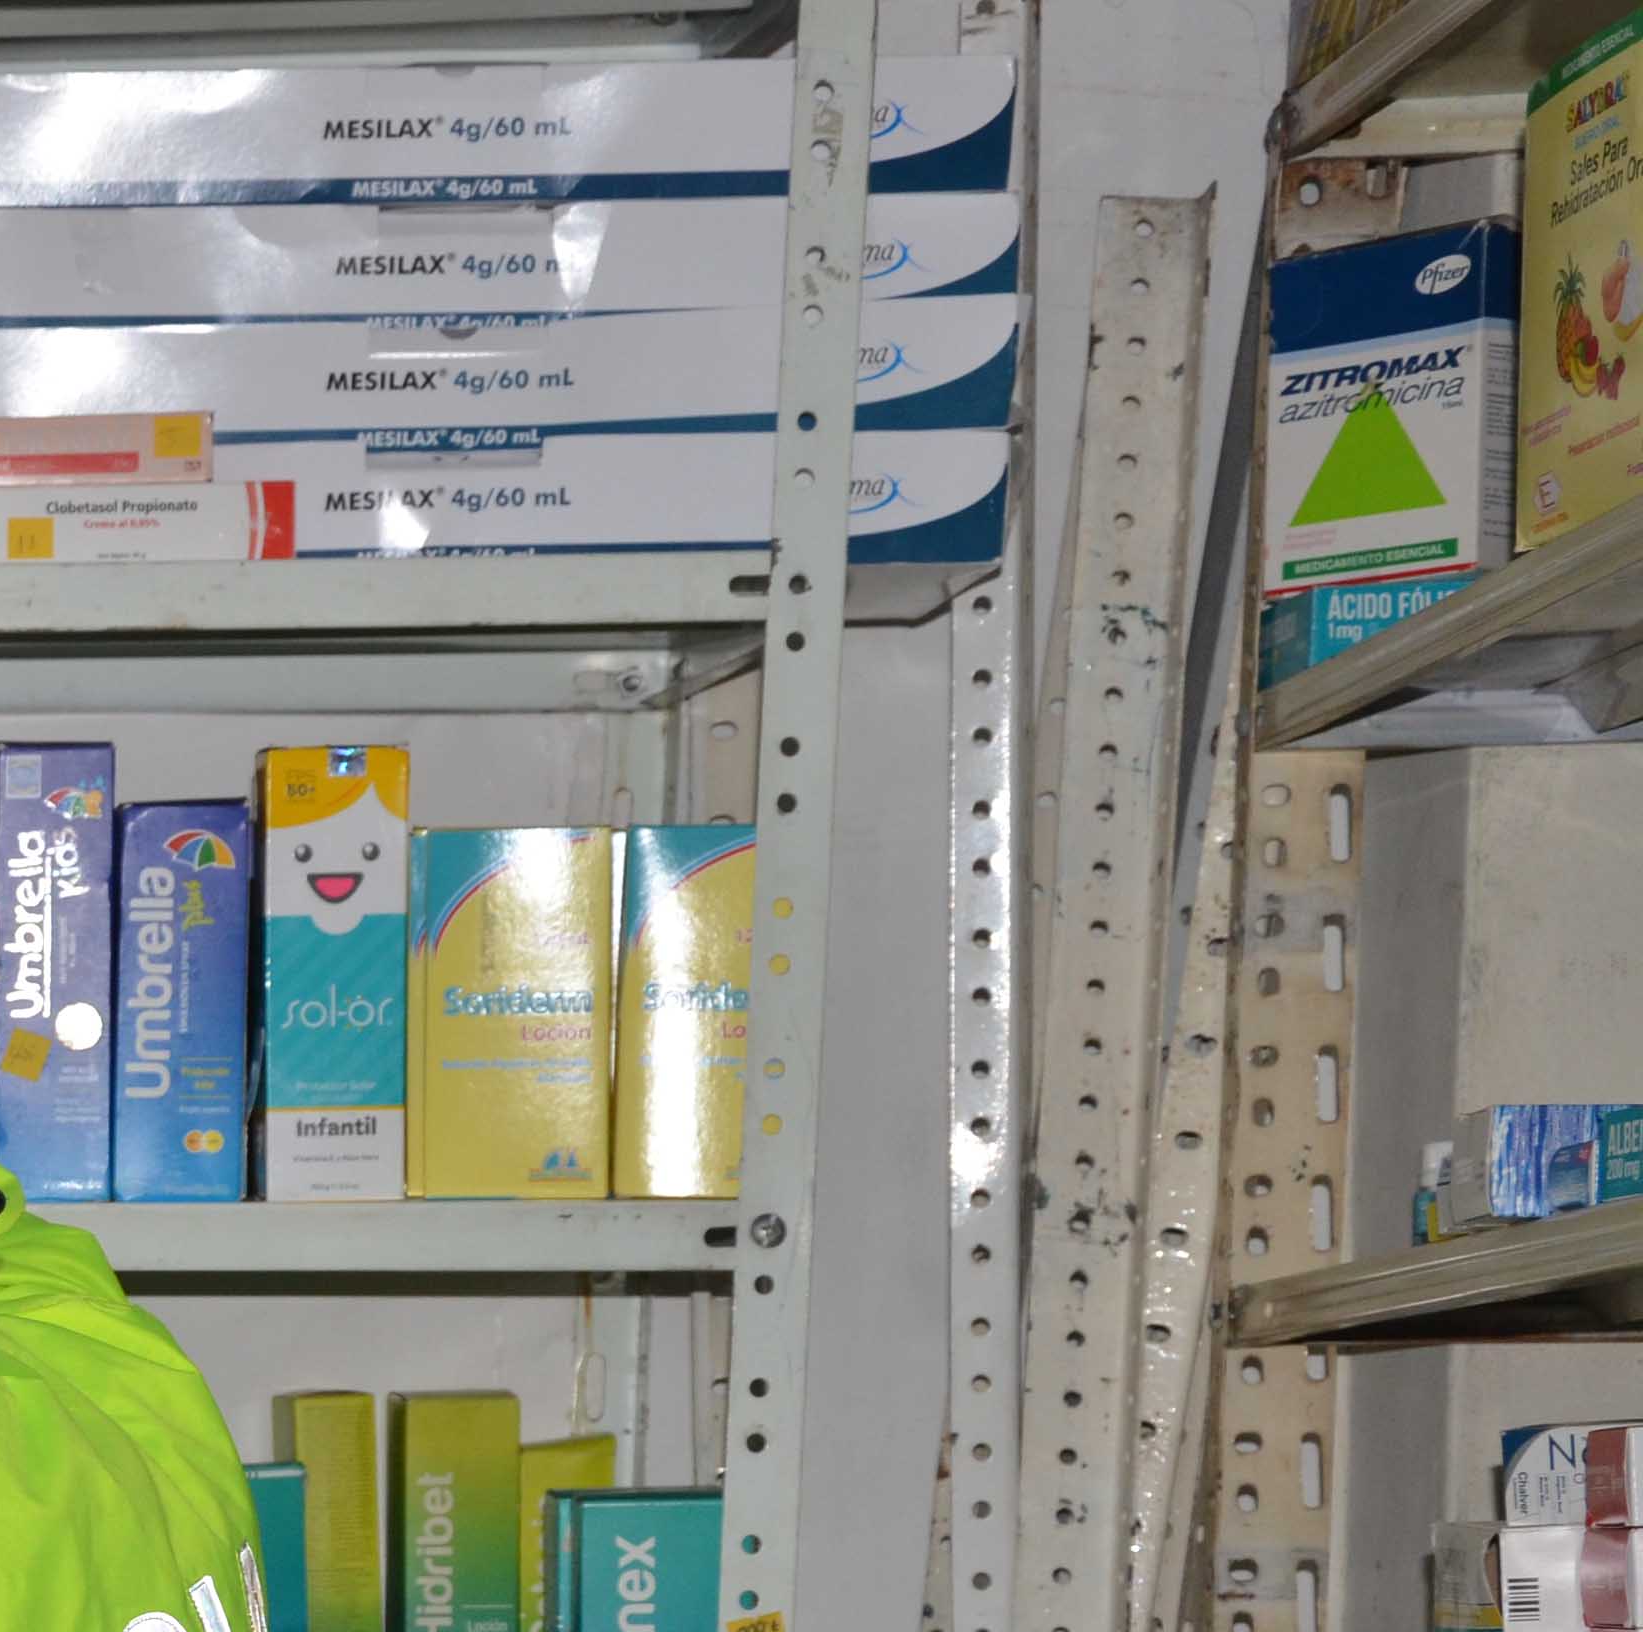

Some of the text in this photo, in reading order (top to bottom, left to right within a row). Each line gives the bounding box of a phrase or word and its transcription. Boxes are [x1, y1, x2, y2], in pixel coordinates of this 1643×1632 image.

[323, 118, 434, 140] MESILAX
[450, 117, 525, 143] 4g/60
[1570, 136, 1629, 187] Sales Para
[352, 181, 435, 198] MESILAX
[446, 181, 504, 198] 4g/60
[335, 254, 536, 280] MESILAX 4g/60
[1421, 257, 1469, 295] Pfizer
[326, 368, 574, 395] MESILAX 4g/60 mL
[1281, 345, 1465, 397] ZITROMAX
[1279, 376, 1465, 424] azitromicina
[357, 430, 440, 447] MESILAX
[450, 430, 508, 448] 4g/60
[46, 499, 198, 516] Clobetasol Propionato
[451, 488, 571, 513] 4g/60 mL
[1327, 589, 1393, 620] ÁCIDO
[5, 828, 46, 1020] Umbrella
[125, 865, 176, 1099] Umbrella
[296, 1116, 377, 1138] Infantil
